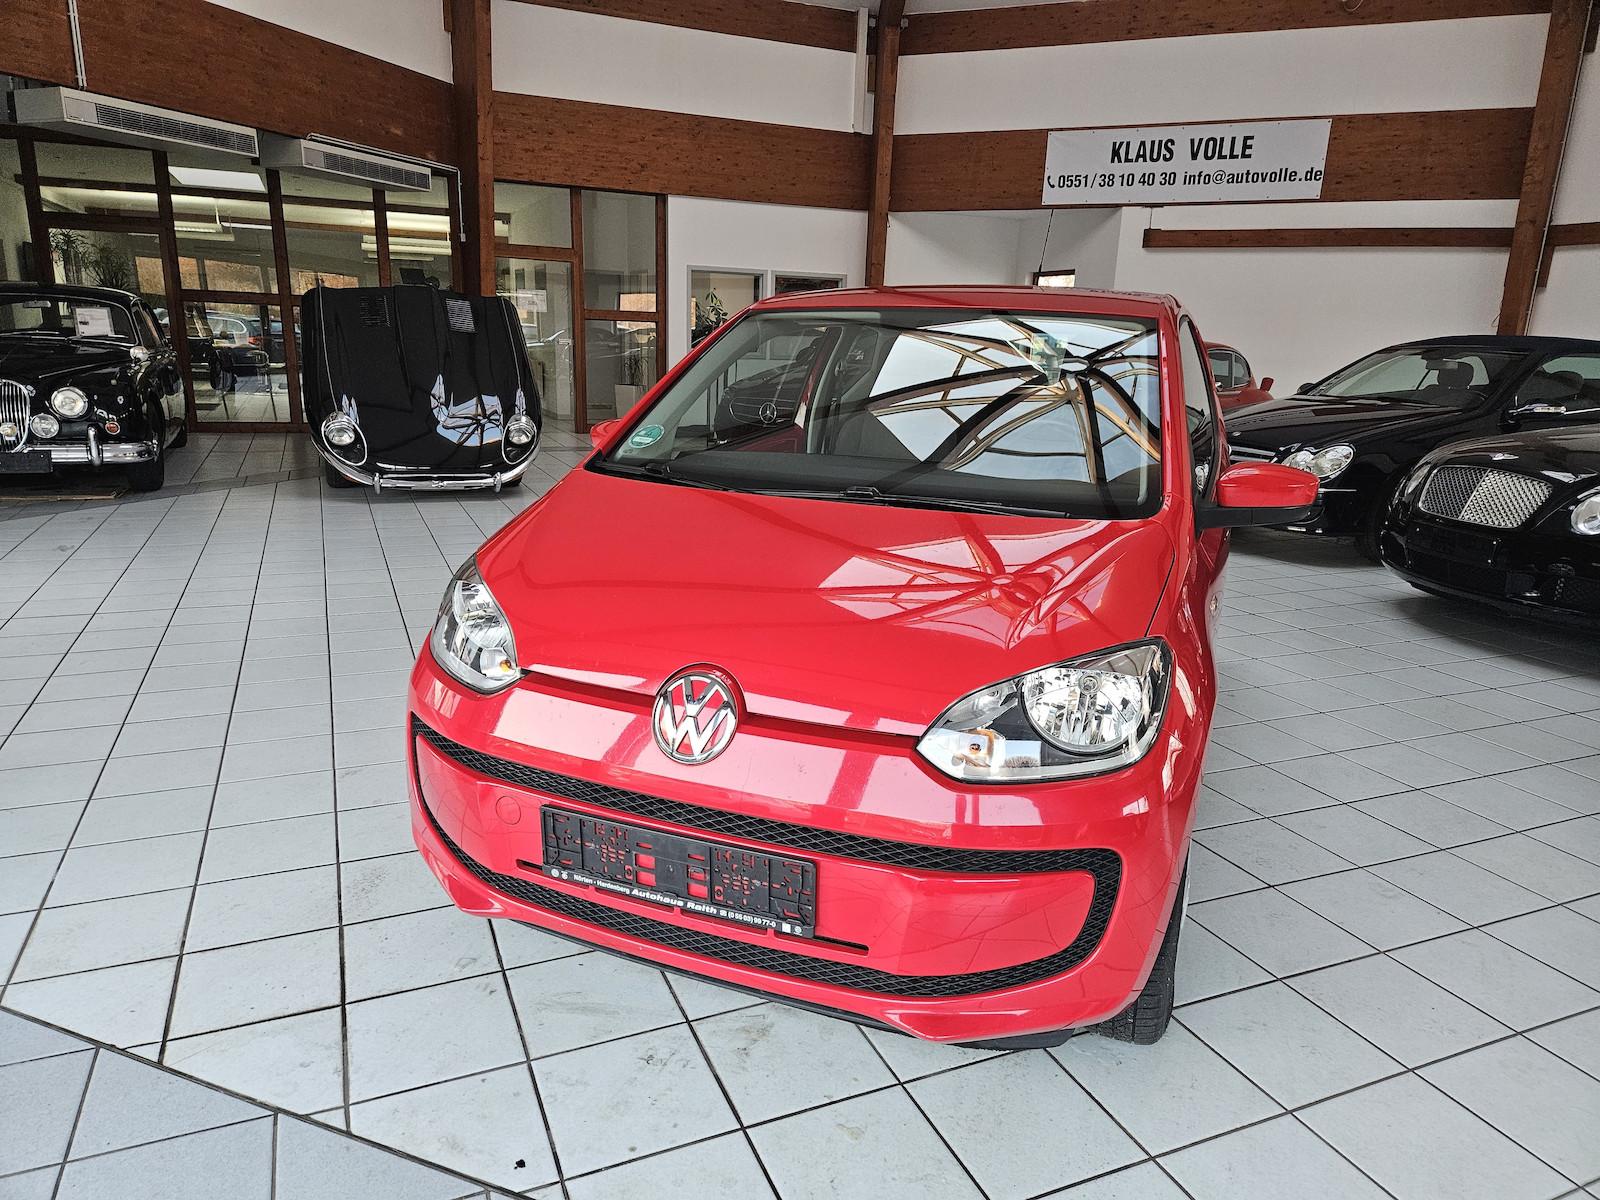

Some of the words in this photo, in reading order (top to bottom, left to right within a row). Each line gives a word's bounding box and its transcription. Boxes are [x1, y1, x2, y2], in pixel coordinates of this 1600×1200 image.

[1110, 138, 1176, 164] KLAUS
[1189, 135, 1255, 161] VOLLE
[1119, 172, 1135, 188] 10
[1138, 172, 1156, 187] 40
[1159, 171, 1177, 187] 30
[1183, 166, 1323, 186] info@autovolle.de
[631, 888, 684, 907] Autohaus
